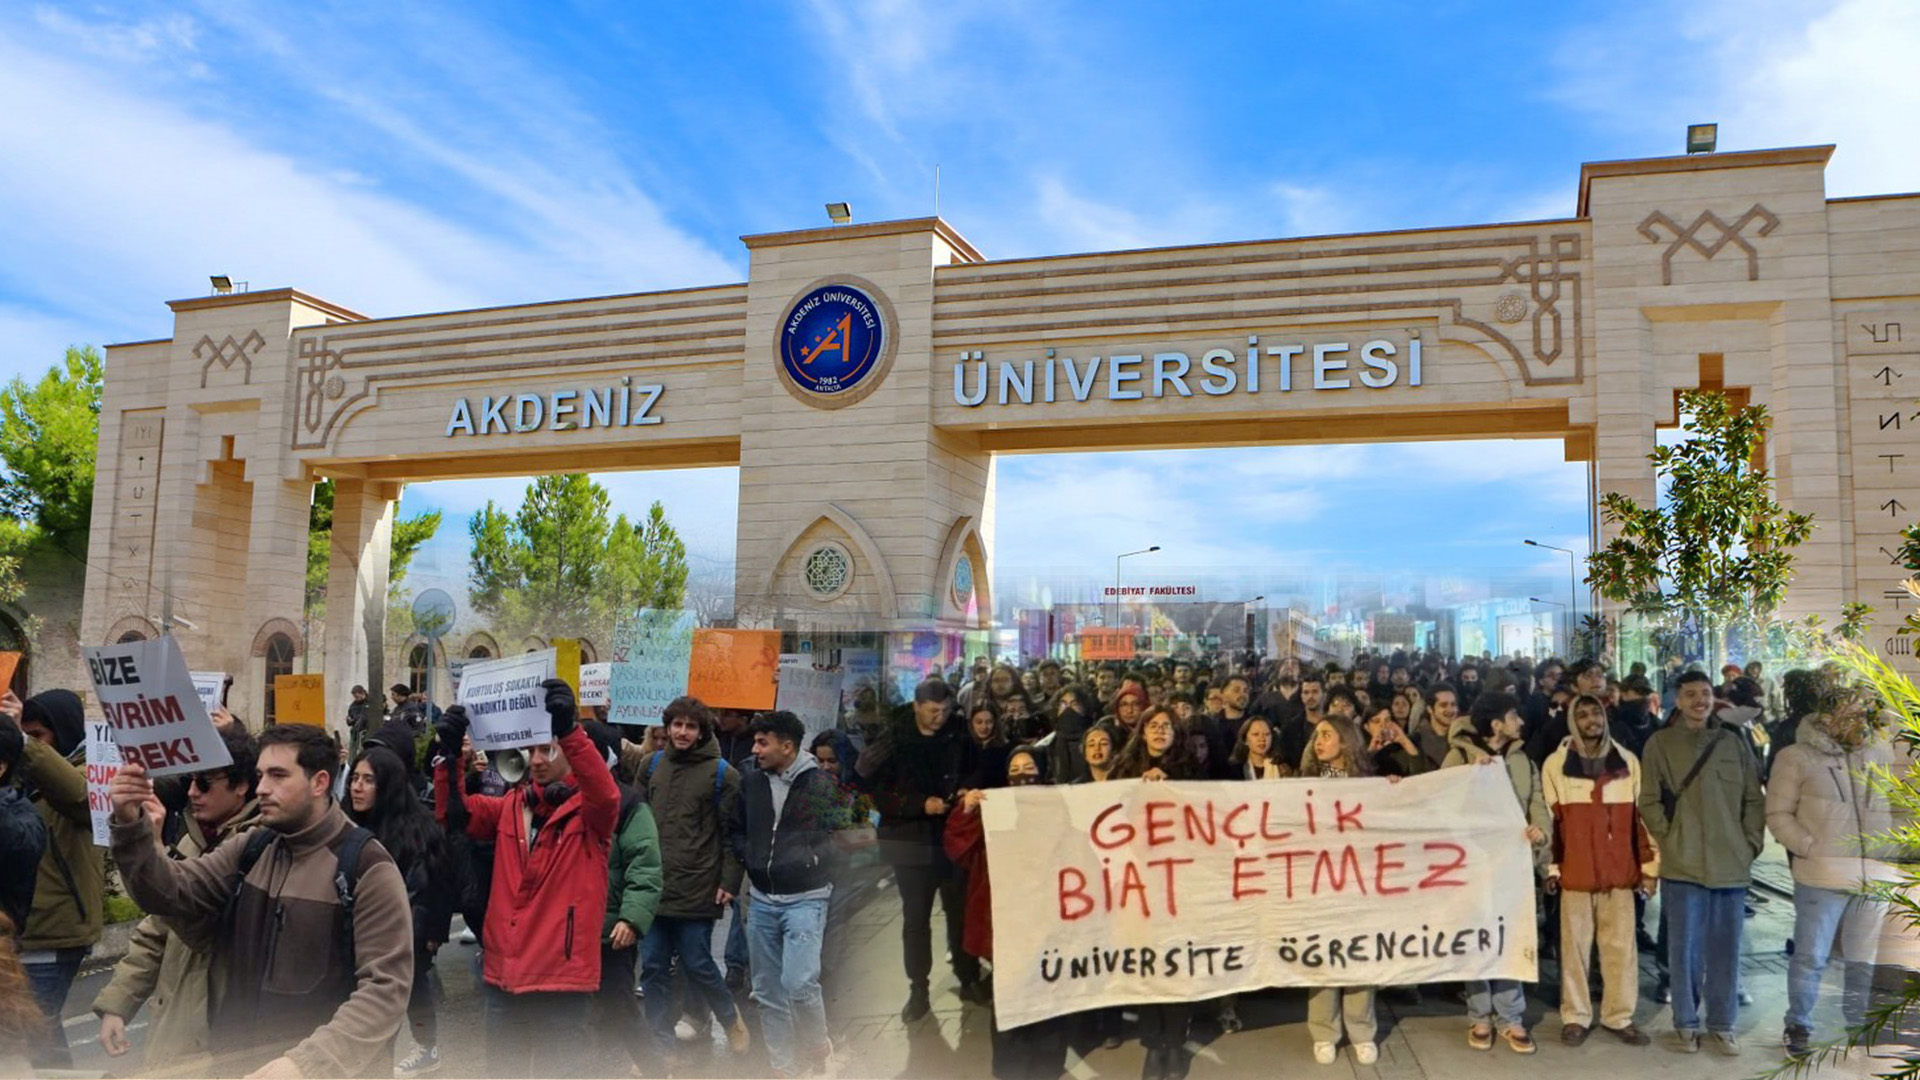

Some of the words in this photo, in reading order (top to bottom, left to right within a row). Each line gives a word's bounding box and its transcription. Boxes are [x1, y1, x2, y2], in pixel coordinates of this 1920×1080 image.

[788, 298, 821, 335] AKDENİZ
[823, 291, 876, 329] ÜNİVERSİTESİ
[819, 376, 838, 385] 1982
[953, 329, 1422, 406] ÜNİVERSİTESİ
[445, 376, 665, 437] AKDENİZ
[1104, 586, 1145, 595] EDEBİYAT
[1150, 585, 1196, 595] FAKÜLTESİ
[88, 651, 141, 687] BİZE
[505, 675, 541, 692] SOKAKTA
[509, 693, 538, 711] DEĞİL!
[1090, 789, 1364, 851] GENÇLİK
[1058, 855, 1194, 920] BİAT
[1232, 842, 1468, 900] ETMEZ
[1041, 941, 1244, 982] ÜNİVERSİTE
[1279, 916, 1504, 968] ÖĞRENCİLERİ
